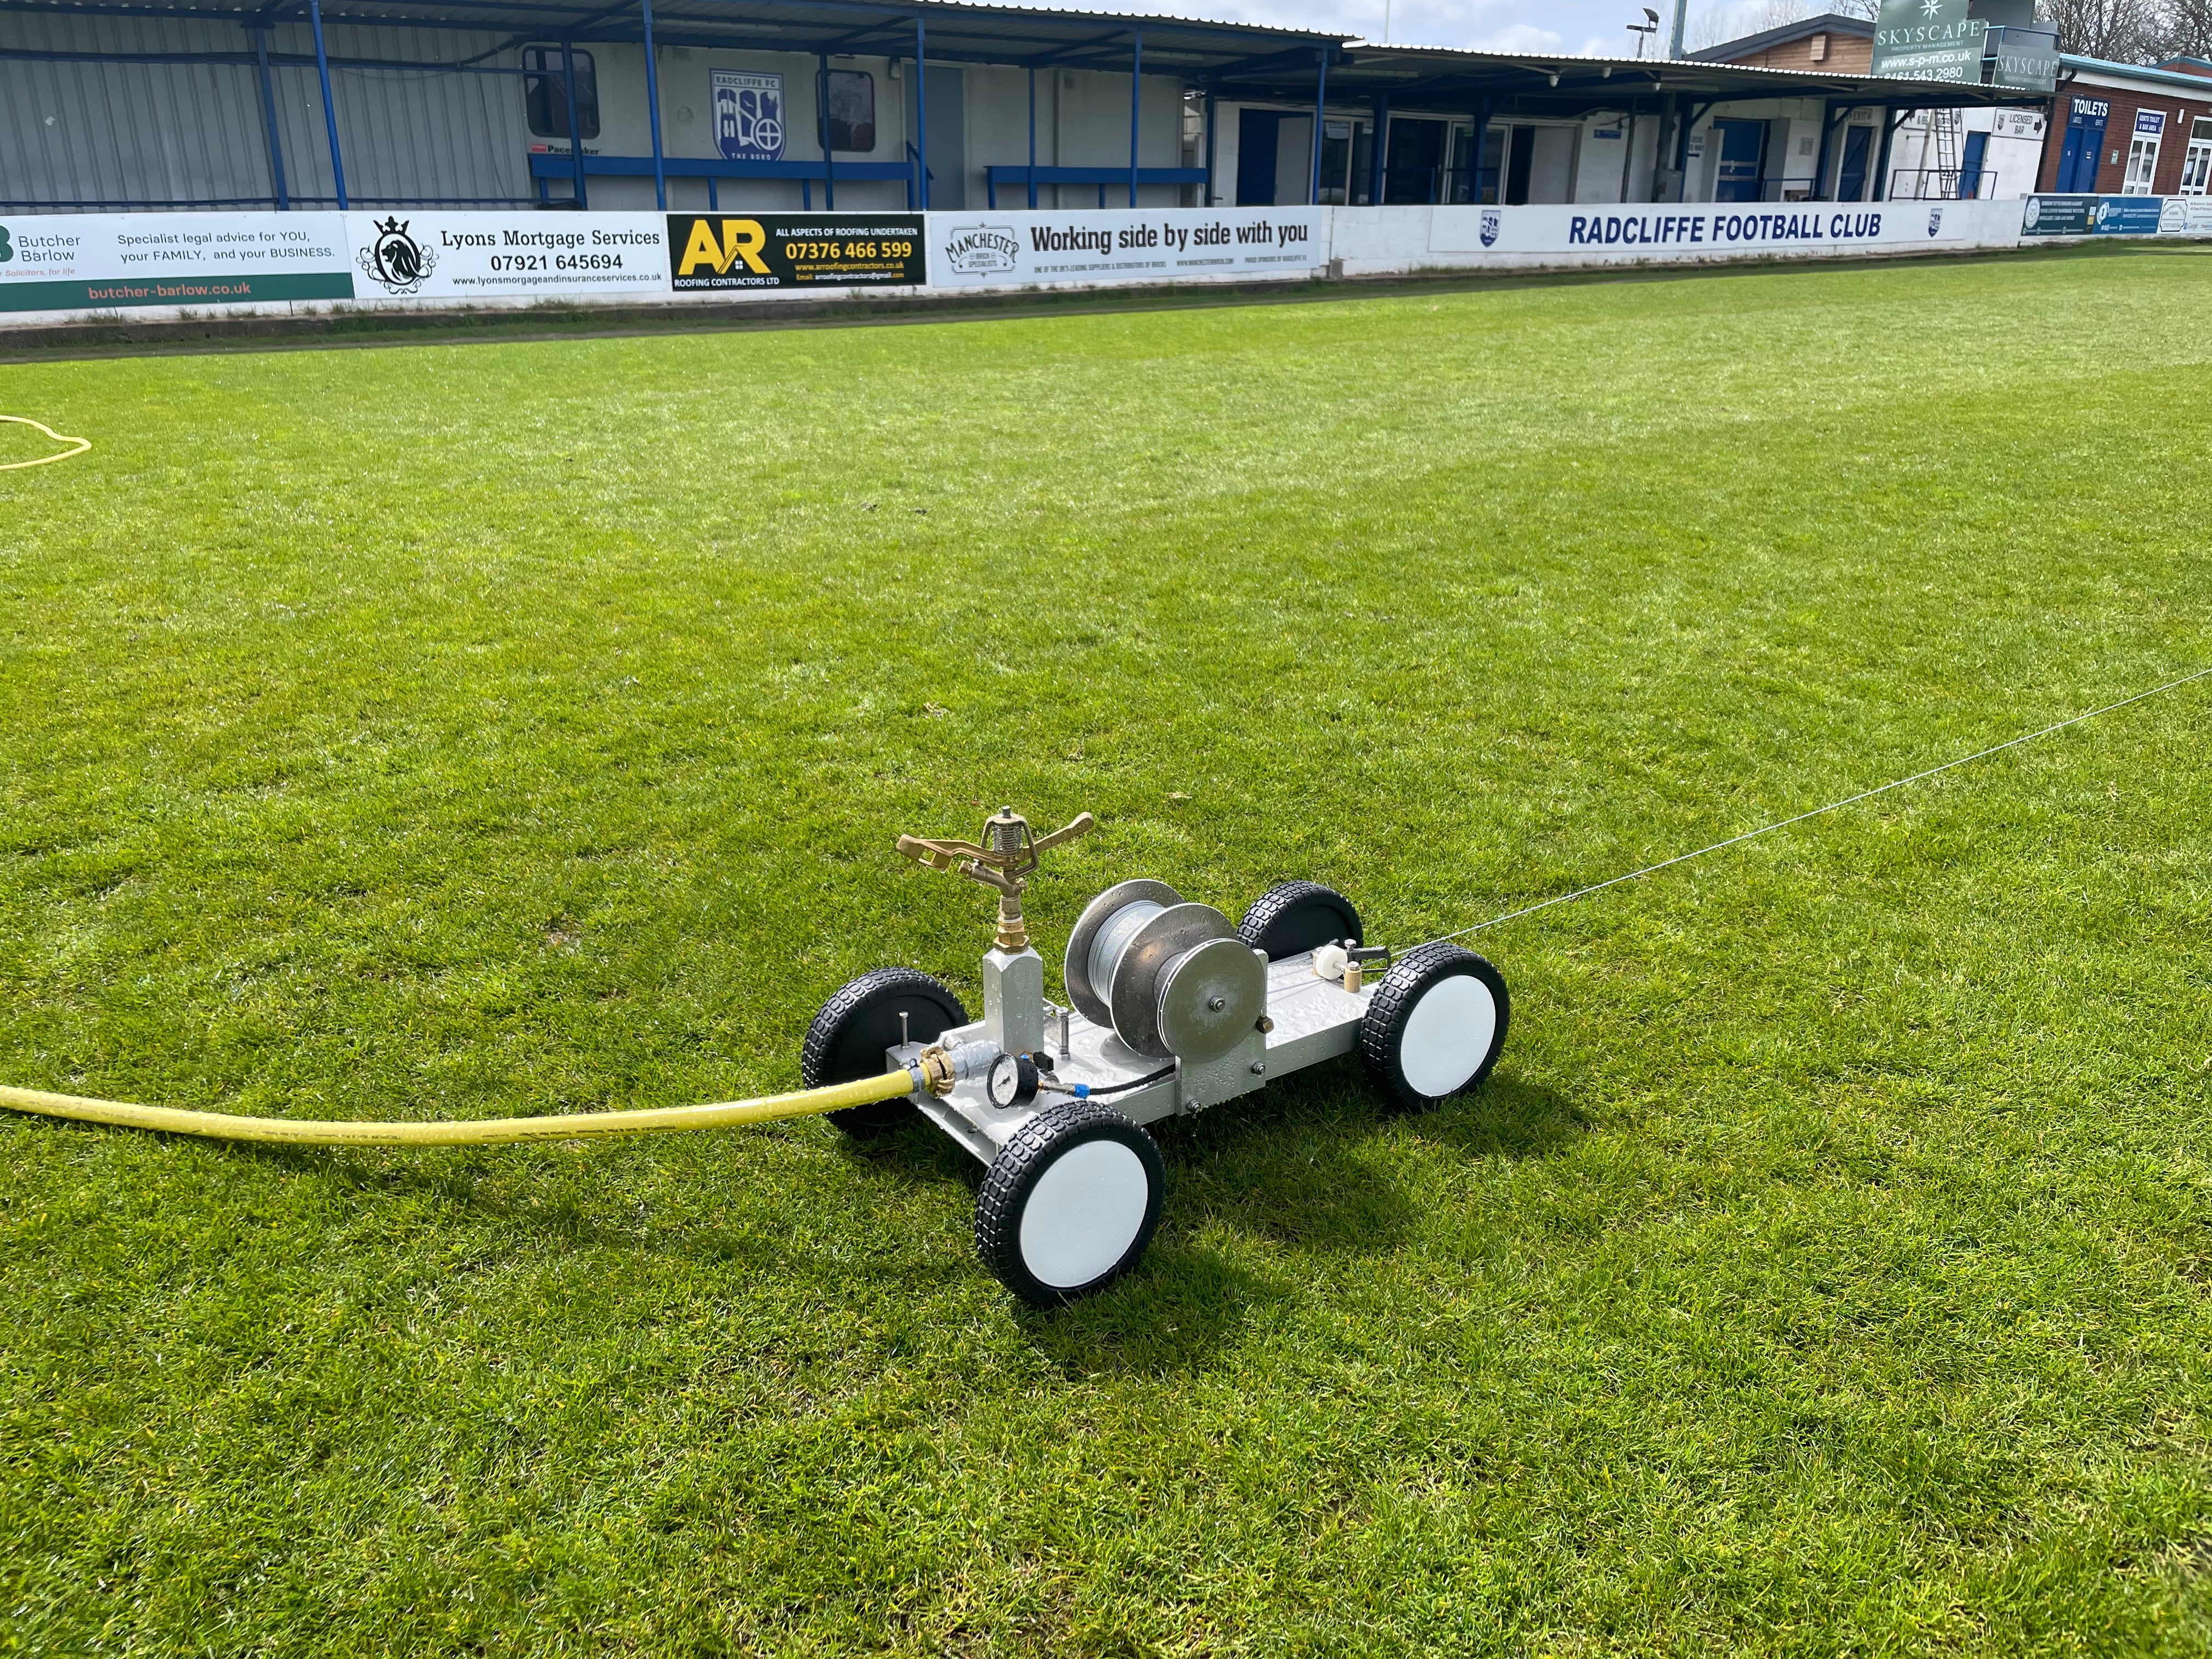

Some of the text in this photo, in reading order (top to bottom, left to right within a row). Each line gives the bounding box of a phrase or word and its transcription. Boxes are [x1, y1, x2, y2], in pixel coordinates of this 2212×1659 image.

[1878, 21, 1980, 46] SKYSCAPE
[1891, 40, 1964, 52] PROPERTY MANAGEMENT
[1881, 50, 1971, 69] www.s-p-m.co.uk
[1997, 55, 2057, 77] SKYSCAPE
[715, 76, 762, 86] RADCLIFFE
[1914, 69, 1933, 79] 543
[1936, 66, 1963, 79] 2980
[2074, 98, 2108, 117] TOILETS
[2010, 113, 2033, 124] LICENSED
[2015, 125, 2025, 135] BAR
[548, 145, 600, 156] Paceker
[776, 228, 789, 236] ALL
[791, 228, 823, 236] ASPECTS
[836, 228, 870, 236] ROOFING
[871, 228, 918, 236] UNDERTAKEN
[1569, 213, 1882, 244] RADCLIFFE FOOTBALL CLUB
[18, 234, 81, 247] Butcher
[117, 230, 311, 247] Specialist legal advice for YOU,
[441, 229, 660, 250] Lyons Mortgage Services
[1030, 221, 1308, 255] Working side by side with you
[21, 249, 75, 262] Barlow
[678, 219, 772, 275] AR
[786, 241, 912, 259] 07376 466 599
[945, 233, 1020, 263] MANCHESTER
[120, 247, 335, 265] your FAMILY, and your BUSINESS.
[490, 254, 623, 271] 07921 645694
[49, 268, 60, 276] for
[63, 267, 76, 276] life
[795, 261, 904, 271] www.arroofingcontractors.co.uk
[452, 273, 662, 286] www.lyonsmorgageandinsuranceservices.co.uk
[674, 278, 709, 287] ROOFING
[711, 277, 765, 286] CONTRACTORS
[88, 281, 251, 300] butcher-barlow.co.uk
